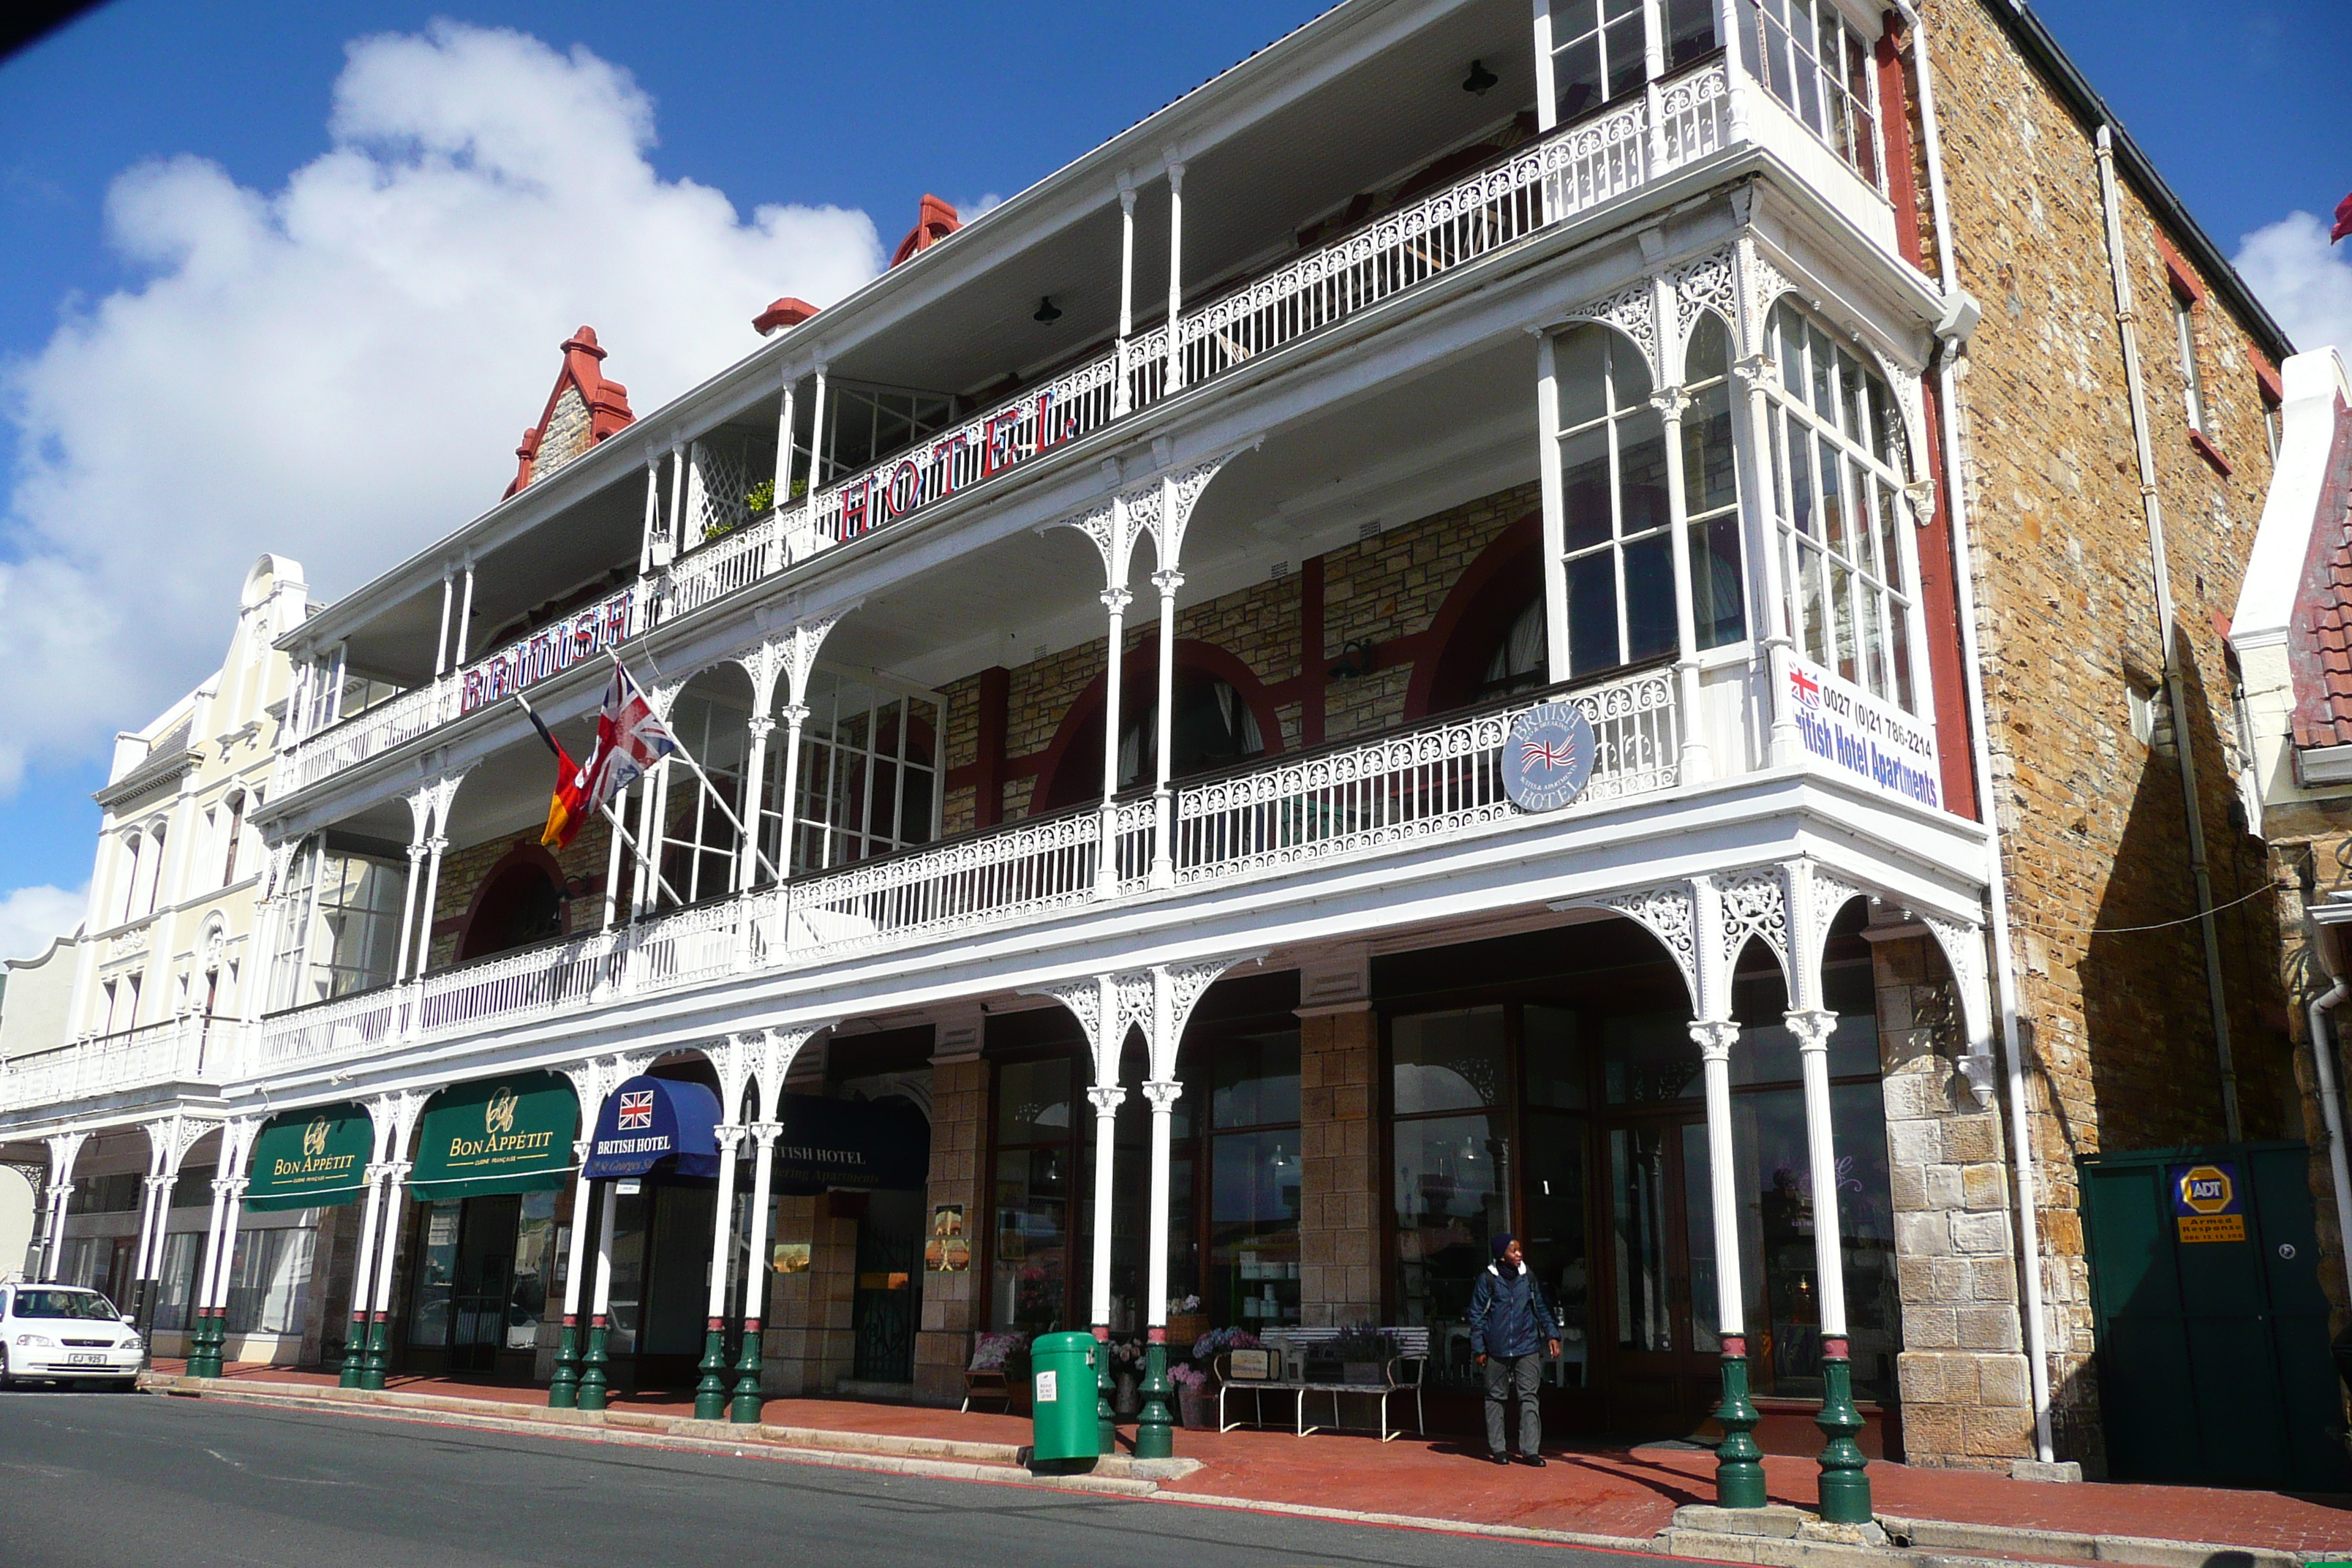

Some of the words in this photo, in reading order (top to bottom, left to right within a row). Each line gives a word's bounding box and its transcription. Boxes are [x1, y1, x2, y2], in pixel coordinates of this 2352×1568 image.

[461, 588, 635, 715] BRITISH
[837, 390, 1077, 542] HOTEL
[1512, 705, 1583, 742] BRITISH
[1539, 720, 1570, 733] BREAKFAST
[1823, 686, 1850, 718] 0027
[1855, 702, 1882, 734] (0)21
[1885, 718, 1932, 760] 786-2214
[1795, 707, 1833, 761] ritish
[1834, 723, 1869, 777] Hotel
[1871, 741, 1937, 808] Apartments
[1520, 775, 1537, 790] SUITES
[1544, 764, 1578, 791] APARTMENTS
[1518, 780, 1581, 810] HOTEL
[449, 1138, 484, 1157] BON
[484, 1130, 554, 1153] APPÉTIT
[597, 1139, 636, 1155] BRITISH
[636, 1135, 671, 1153] HOTEL
[274, 1158, 301, 1176] BON
[301, 1154, 355, 1172] APPÉTIT
[772, 1145, 813, 1161] ITISH
[817, 1148, 867, 1165] HOTEL
[813, 1169, 880, 1185] Apartments
[2193, 1181, 2221, 1197] ADT
[2182, 1225, 2242, 1233] Response
[2190, 1217, 2232, 1225] Armed
[88, 1355, 102, 1363] 925
